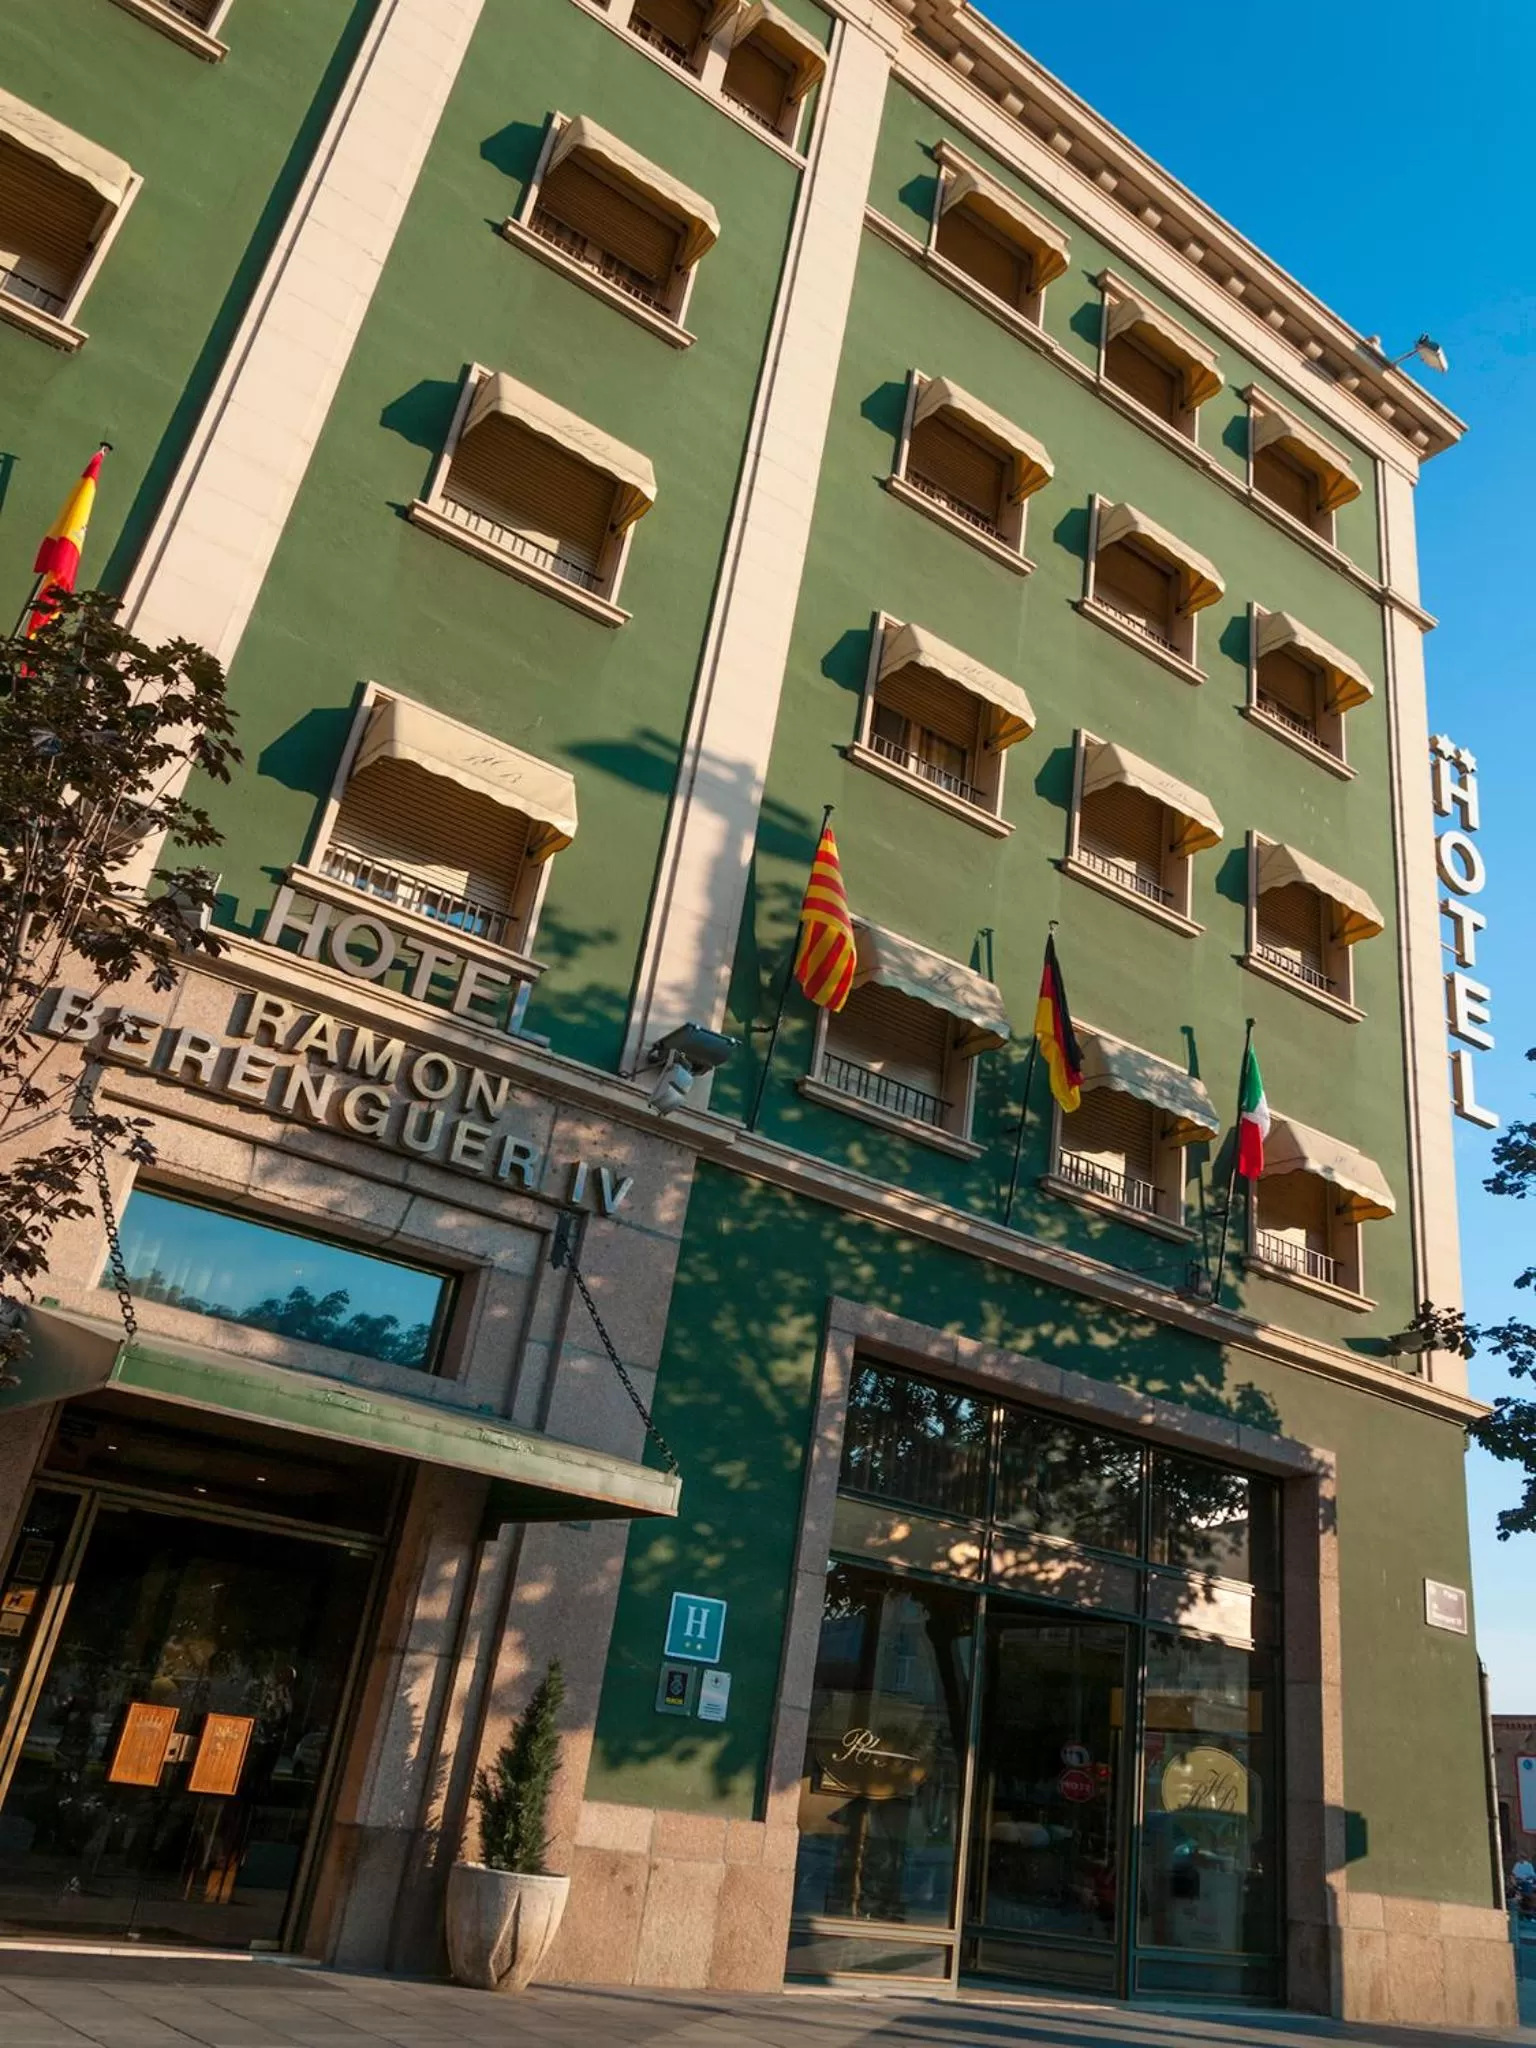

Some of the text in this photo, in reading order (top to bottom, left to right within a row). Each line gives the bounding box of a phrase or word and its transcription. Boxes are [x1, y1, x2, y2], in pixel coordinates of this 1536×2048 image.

[261, 884, 551, 1050] HOTEL
[1434, 757, 1500, 1130] HOTEL
[46, 985, 634, 1216] BERENGUER IV
[243, 990, 512, 1121] RAMON
[684, 1604, 711, 1639] H
